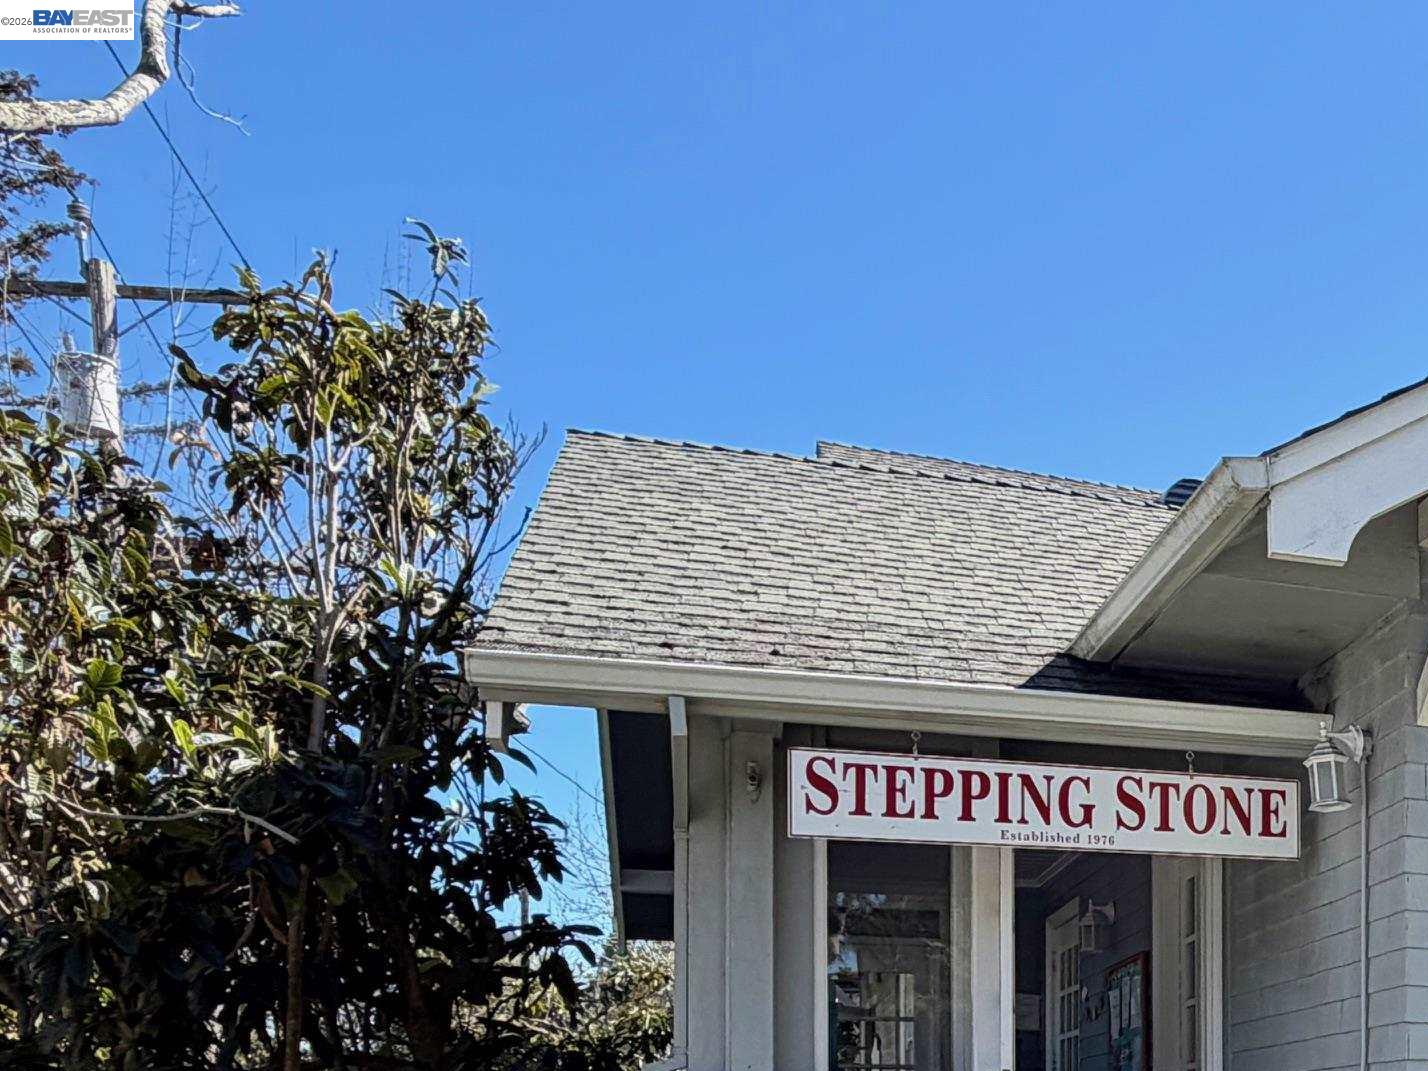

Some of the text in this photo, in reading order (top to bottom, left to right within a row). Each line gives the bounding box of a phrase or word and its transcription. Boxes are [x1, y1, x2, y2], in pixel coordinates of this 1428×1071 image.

[805, 756, 1287, 838] STEPPING STONE
[1000, 829, 1116, 847] Established 1976
